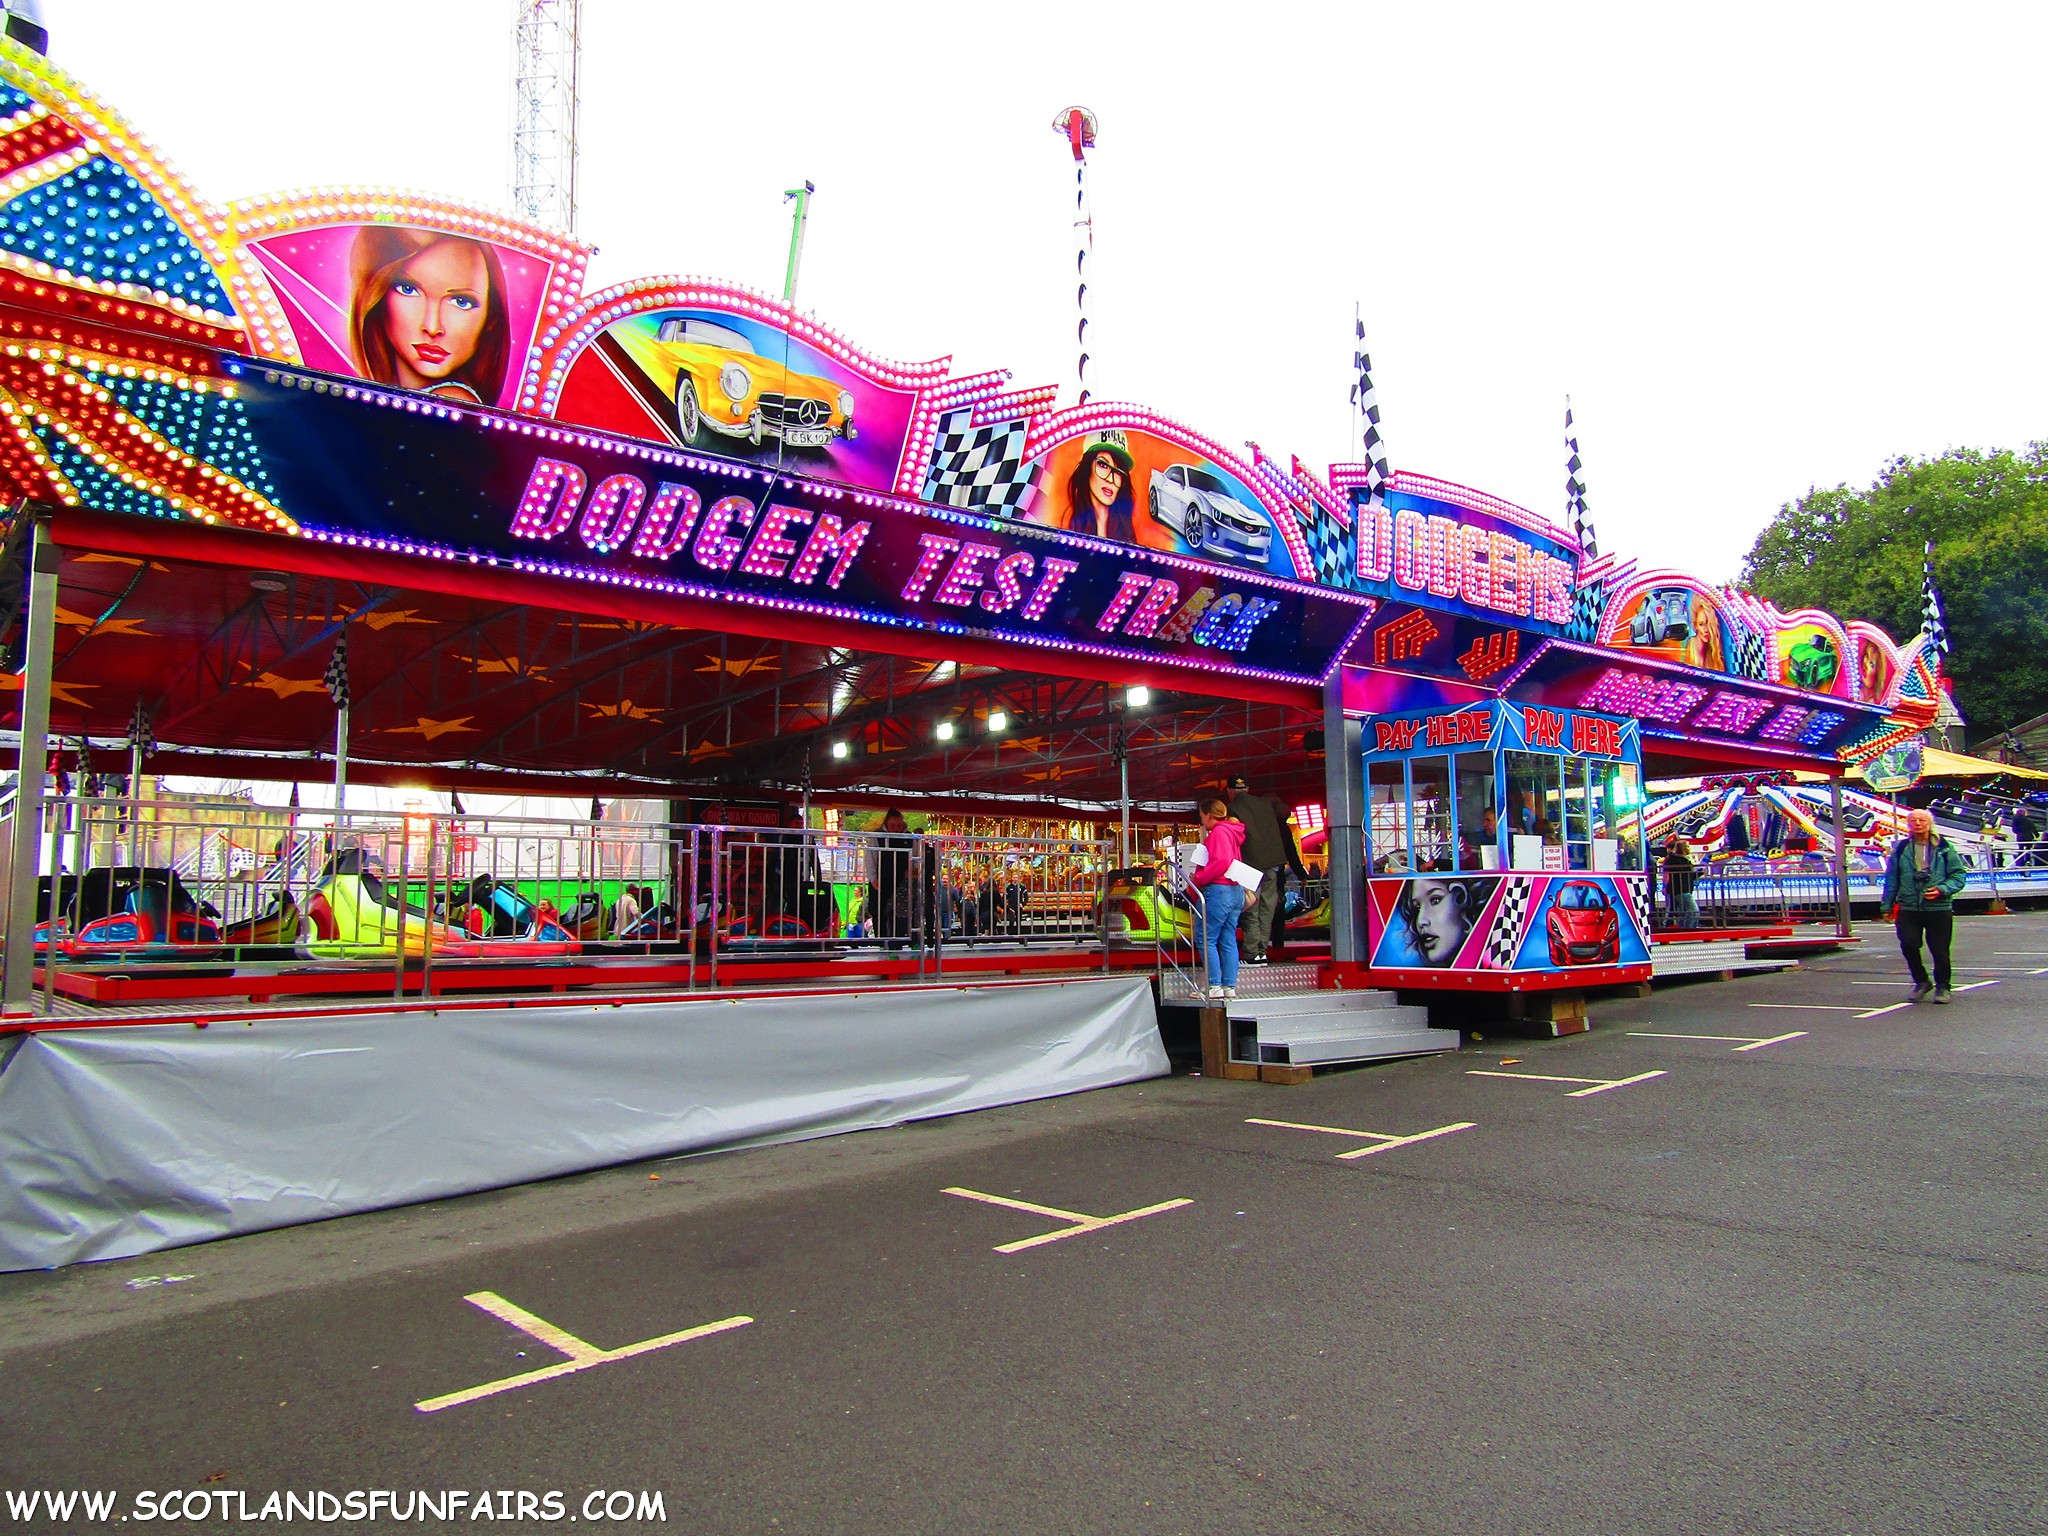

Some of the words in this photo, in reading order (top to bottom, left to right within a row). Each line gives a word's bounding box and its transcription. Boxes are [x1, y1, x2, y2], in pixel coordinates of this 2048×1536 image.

[508, 456, 872, 590] DODGEM
[899, 534, 1079, 622] TEST
[1095, 571, 1281, 652] TRACK
[1357, 504, 1575, 625] DODGEMS
[1375, 719, 1420, 751] PAY
[1426, 710, 1491, 747] HERE
[1523, 707, 1564, 748] PAY
[1572, 714, 1622, 757] HERE
[727, 811, 747, 823] WAY
[749, 812, 777, 825] ROUND
